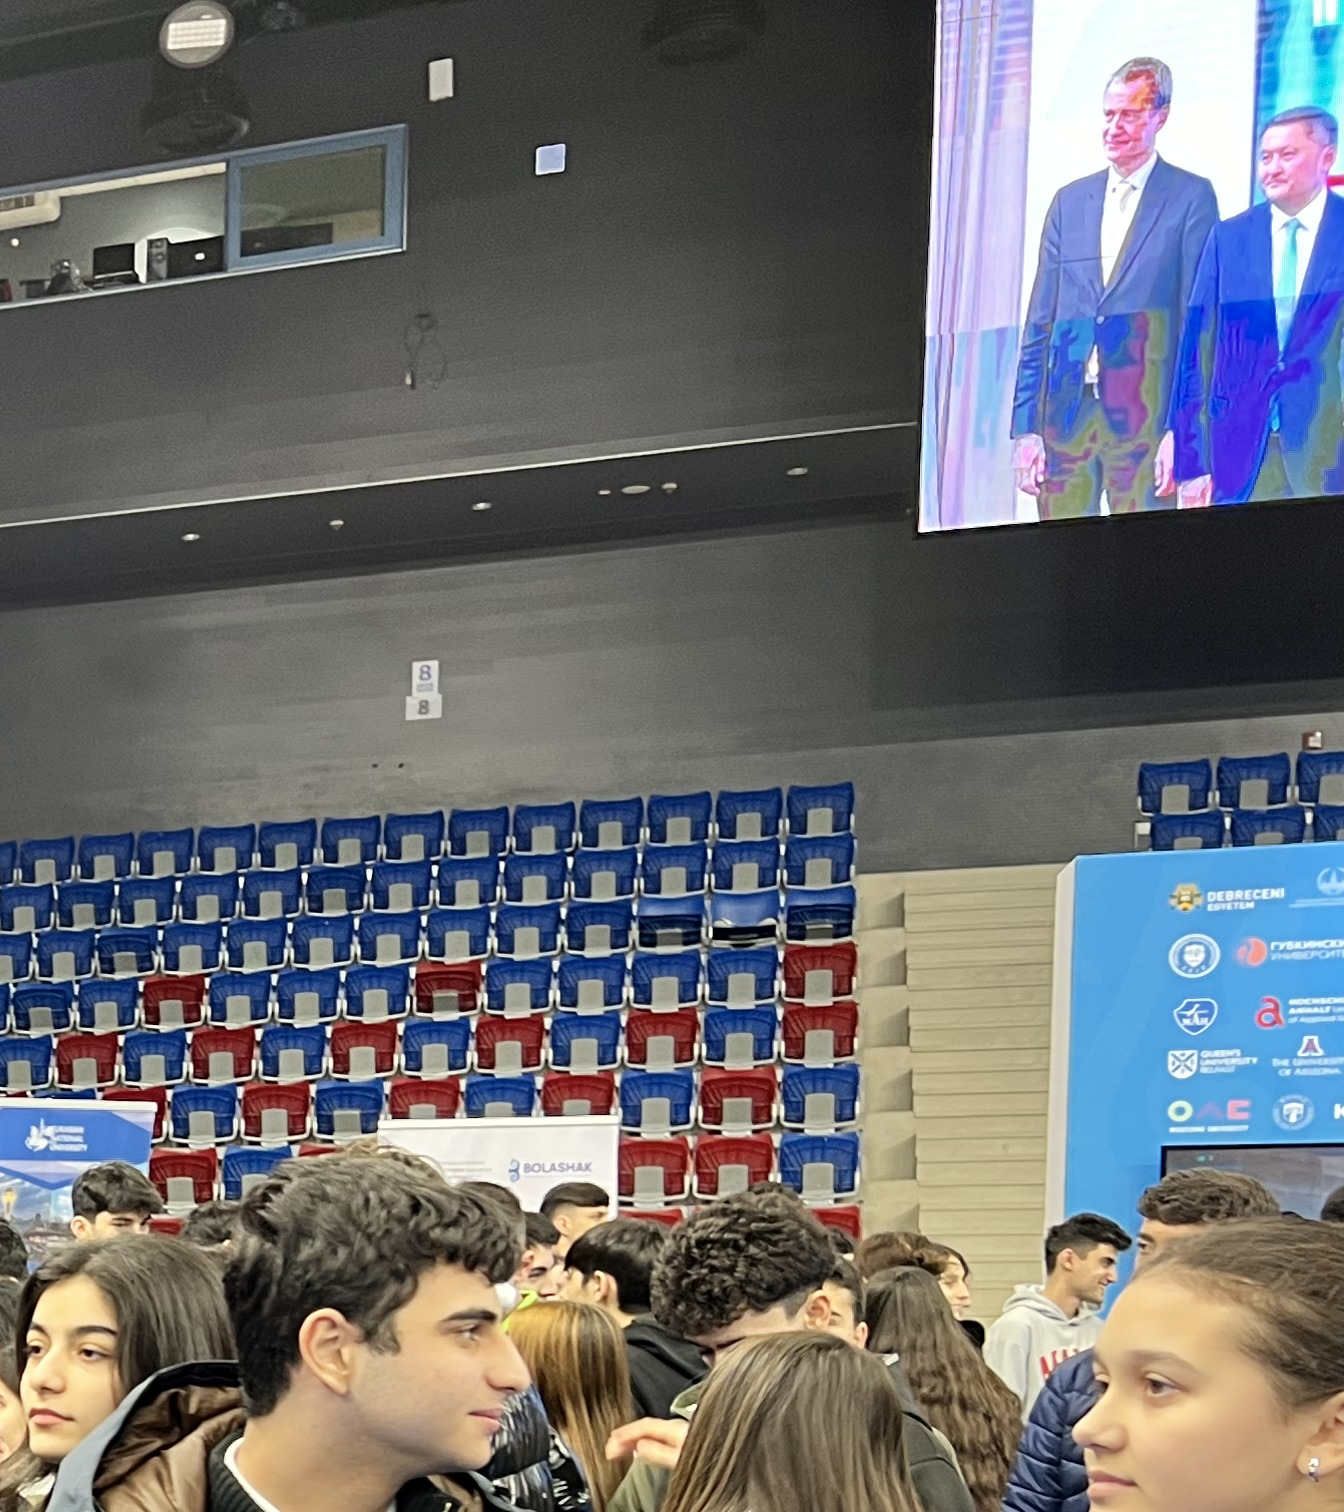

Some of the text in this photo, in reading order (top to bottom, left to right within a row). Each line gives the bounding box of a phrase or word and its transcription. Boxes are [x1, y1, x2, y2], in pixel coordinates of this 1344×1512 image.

[418, 664, 432, 681] 8
[417, 700, 430, 716] 8
[1207, 888, 1286, 903] DEBRECENI
[523, 1162, 593, 1174] BOLASHAK
